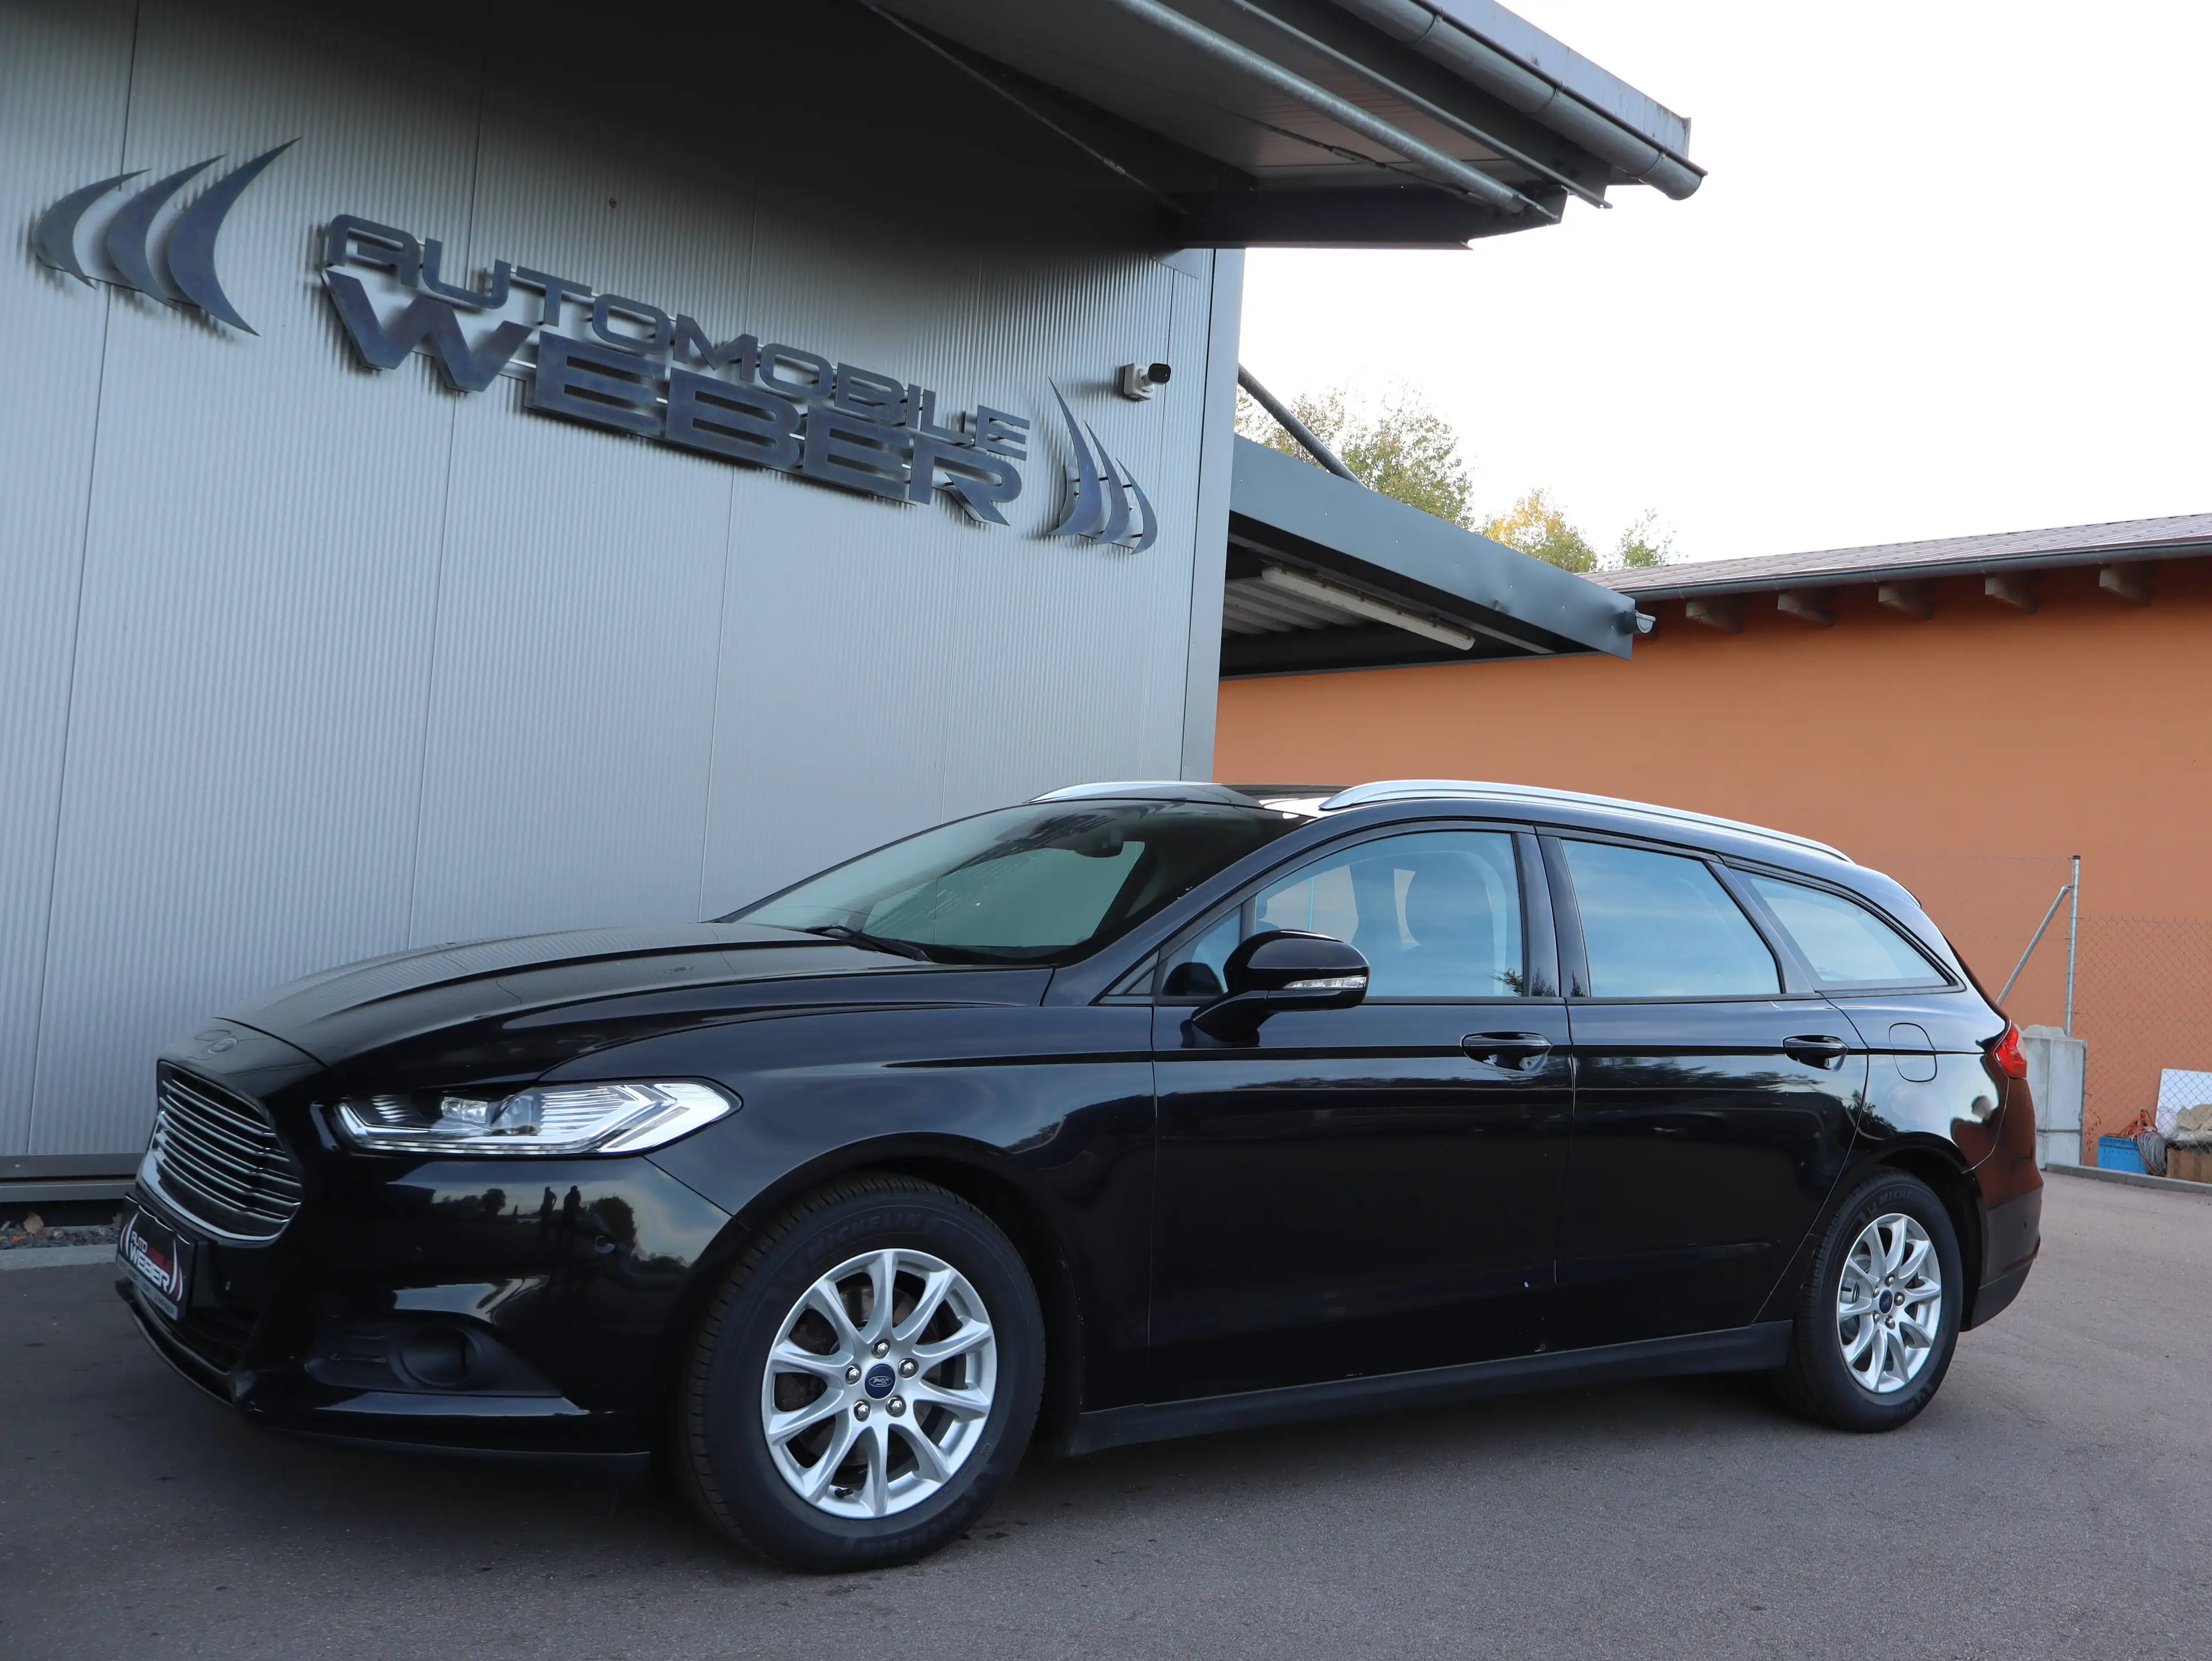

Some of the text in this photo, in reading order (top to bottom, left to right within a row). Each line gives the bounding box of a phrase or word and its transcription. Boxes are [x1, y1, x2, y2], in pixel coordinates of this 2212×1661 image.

[325, 269, 1022, 527] WEBER
[328, 214, 1030, 461] AUTOMOBILE
[129, 1242, 171, 1292] WEBER
[130, 1230, 148, 1253] AUTO
